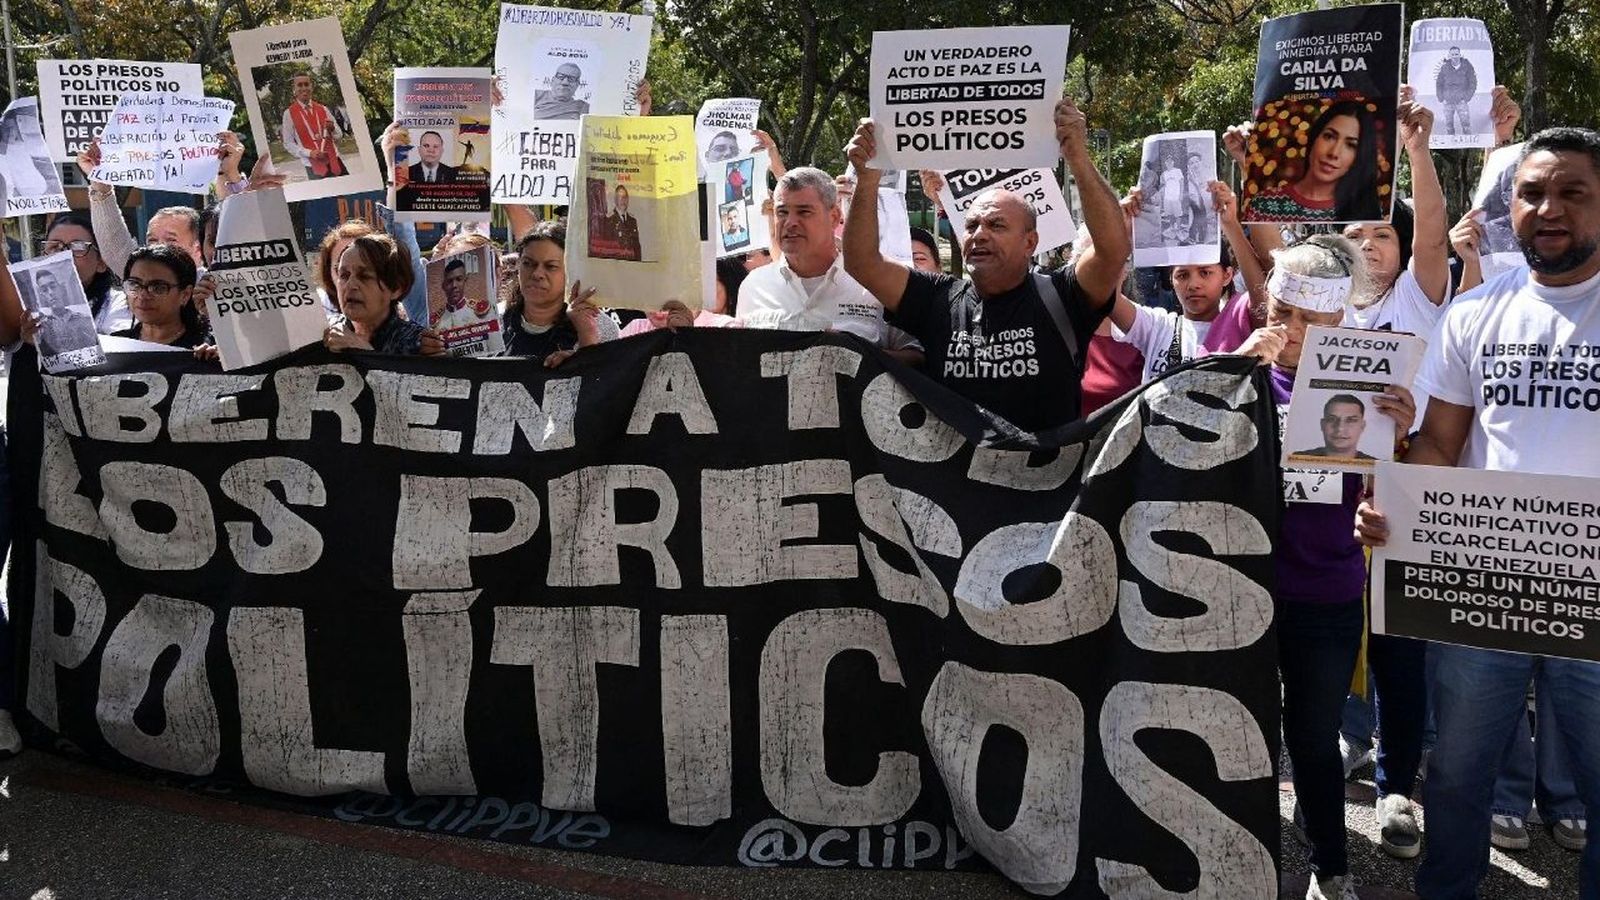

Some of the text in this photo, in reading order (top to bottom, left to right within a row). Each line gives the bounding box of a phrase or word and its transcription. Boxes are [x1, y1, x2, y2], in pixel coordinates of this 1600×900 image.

[1275, 31, 1383, 51] EXIGIMOS LIBERTAD
[1414, 26, 1474, 43] LIBERTAD
[903, 45, 1033, 62] UN VERDADERO
[1279, 43, 1373, 60] INMEDIATA PARA
[58, 64, 165, 78] LOS PRESOS
[887, 62, 1042, 80] ACTO DE PAZ ES LA
[1280, 57, 1368, 76] CARLA DA
[60, 77, 181, 92] POLÍTICOS NO
[887, 83, 1043, 101] LIBERTAD DE TODOS
[1294, 74, 1345, 91] SILVA
[63, 112, 112, 124] A ALI
[115, 113, 141, 125] PAZ
[399, 118, 455, 127] USTO DAZA
[702, 119, 754, 130] CARDENAS
[706, 111, 752, 121] JHOLMAR
[894, 108, 1028, 128] LOS PRESOS
[65, 126, 89, 138] DE
[189, 129, 221, 144] TODO
[896, 128, 1026, 152] POLÍTICOS
[520, 156, 556, 171] PARA
[490, 173, 545, 199] ALDO
[949, 167, 1011, 192] TOD
[954, 170, 1042, 213] LO ESOS
[216, 243, 290, 264] IBERTAD
[212, 265, 302, 285] ARA TODOS
[213, 280, 309, 301] LOS PRESOS
[217, 292, 315, 317] POLÍTICOS
[998, 326, 1035, 342] TODOS
[1318, 335, 1400, 352] JACKSON
[947, 339, 1037, 361] LOS PRESOS
[1482, 343, 1549, 358] LIBEREN
[1552, 344, 1564, 358] A
[943, 358, 1040, 379] POLÍTICOS
[1315, 353, 1392, 375] VERA
[1481, 360, 1522, 380] LOS
[42, 363, 582, 456] IBEREN
[625, 351, 719, 435] A
[1482, 379, 1600, 412] POLÍTICO
[1423, 490, 1600, 518] NO HAY NÚMER
[37, 410, 1275, 653] LOS PRESOS
[1419, 510, 1579, 537] SIGNIFICATIVO
[1412, 529, 1600, 561] EXCARCELACION
[1430, 549, 1596, 581] EN VENEZUELA
[1404, 565, 1600, 603] PERO SÍ UN NÚME
[1404, 584, 1514, 610] DOLOROSO
[1519, 598, 1548, 614] DE
[1450, 607, 1586, 640] POLÍTICOS
[26, 538, 1280, 900] POLÍTICOS
